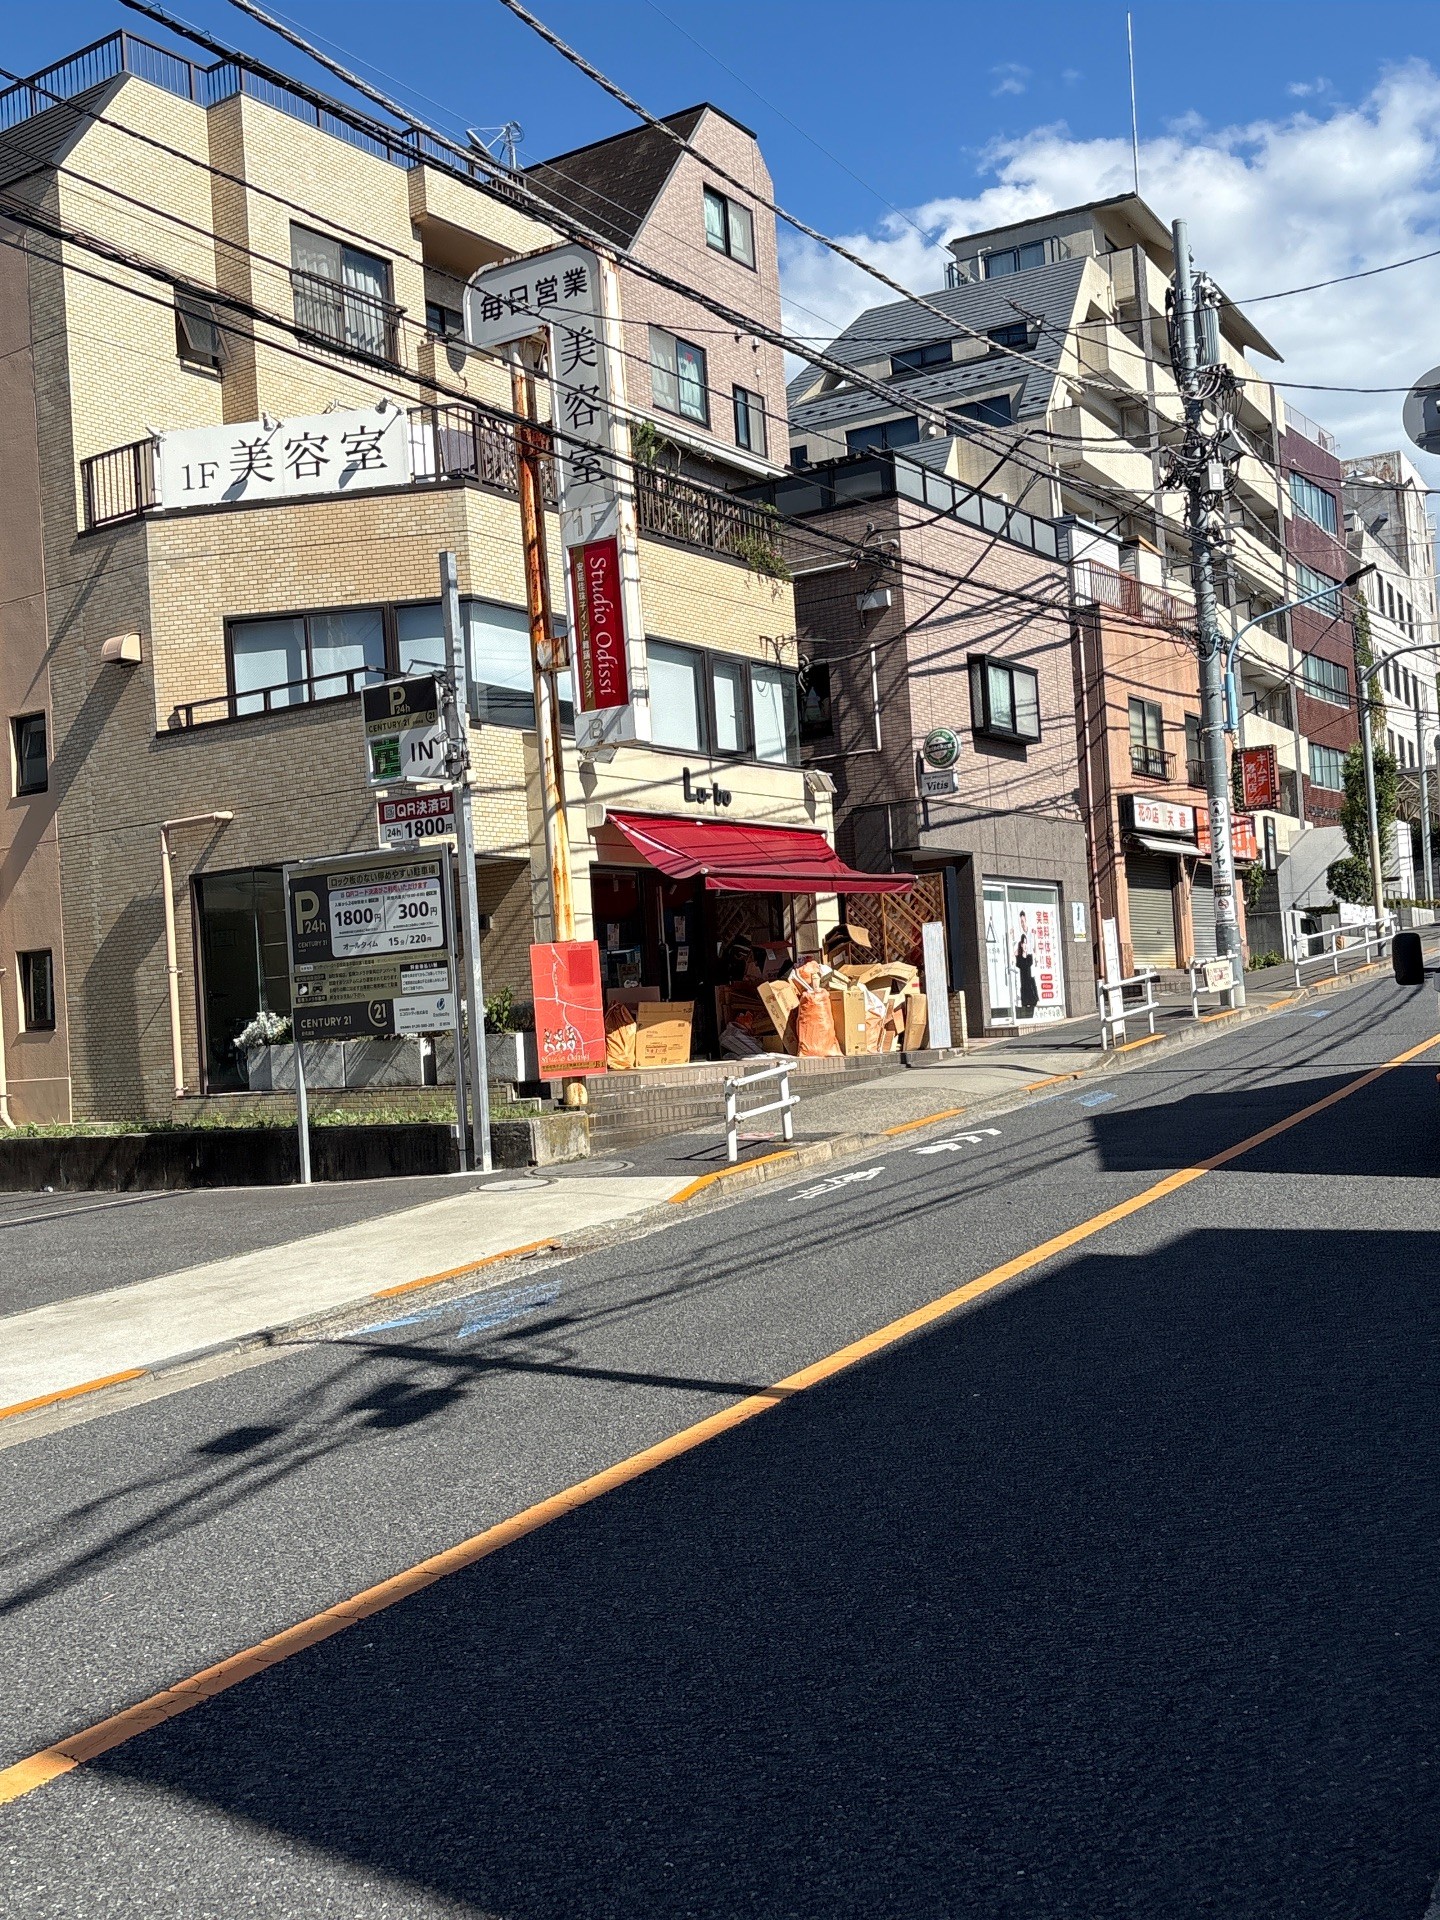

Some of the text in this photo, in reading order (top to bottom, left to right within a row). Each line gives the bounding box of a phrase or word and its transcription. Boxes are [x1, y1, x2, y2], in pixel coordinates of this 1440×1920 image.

[480, 266, 588, 322] 毎日営業
[560, 326, 607, 488] 美容室
[182, 425, 389, 491] 1F 美容室
[590, 556, 618, 696] Studio Odissi
[389, 686, 406, 715] P
[396, 704, 411, 715] 24h
[368, 720, 401, 733] CENTURY
[403, 718, 410, 727] 21
[411, 739, 434, 762] IN
[926, 780, 949, 791] Vitis
[396, 796, 451, 817] QR決済可
[1138, 803, 1159, 824] 花の店
[387, 817, 453, 838] 24h 1800円
[1213, 826, 1226, 869] フジヤ
[295, 891, 320, 934] P
[334, 908, 382, 927] 1800円
[398, 901, 438, 920] 300円
[305, 919, 327, 934] 24h
[343, 941, 379, 950] オールタイム
[374, 1003, 387, 1019] 21
[300, 1015, 352, 1029] CENTURY 21
